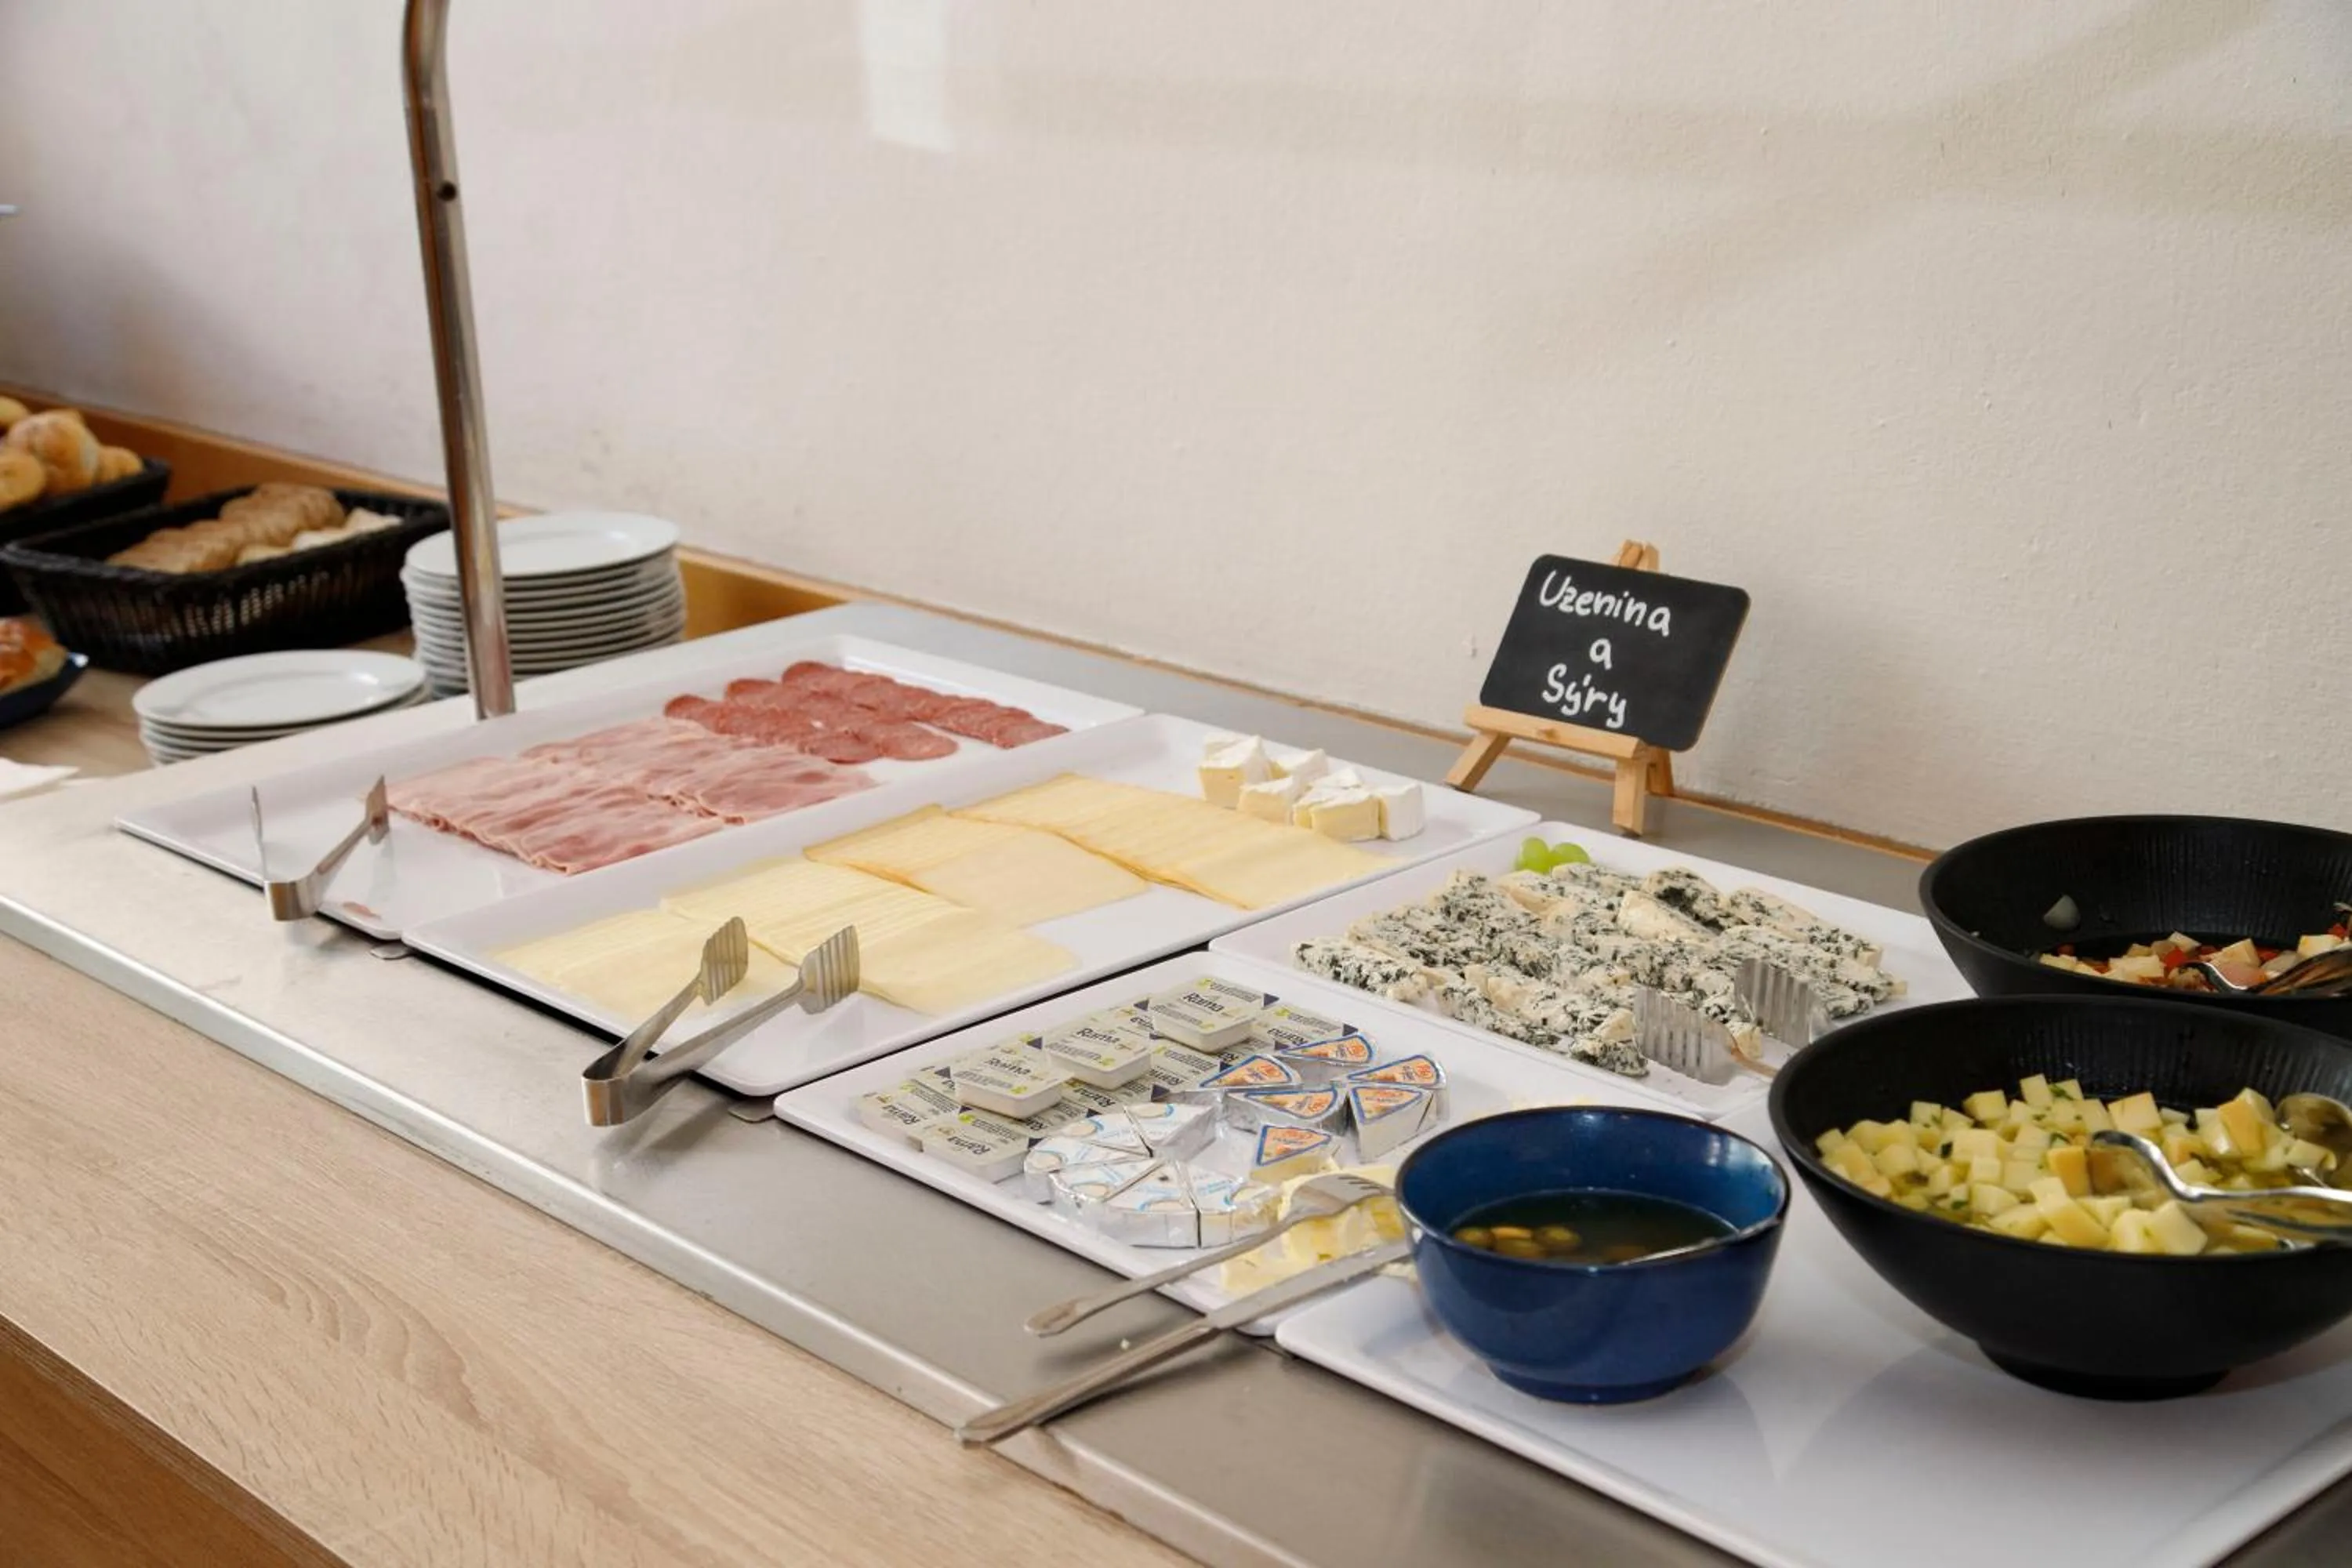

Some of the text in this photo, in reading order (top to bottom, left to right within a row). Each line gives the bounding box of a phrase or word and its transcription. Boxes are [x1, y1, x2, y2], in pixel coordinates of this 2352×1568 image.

[1539, 570, 1671, 637] Uzenina
[1589, 637, 1613, 670] a
[1541, 663, 1628, 729] Sýry
[1181, 992, 1225, 1012] Rama
